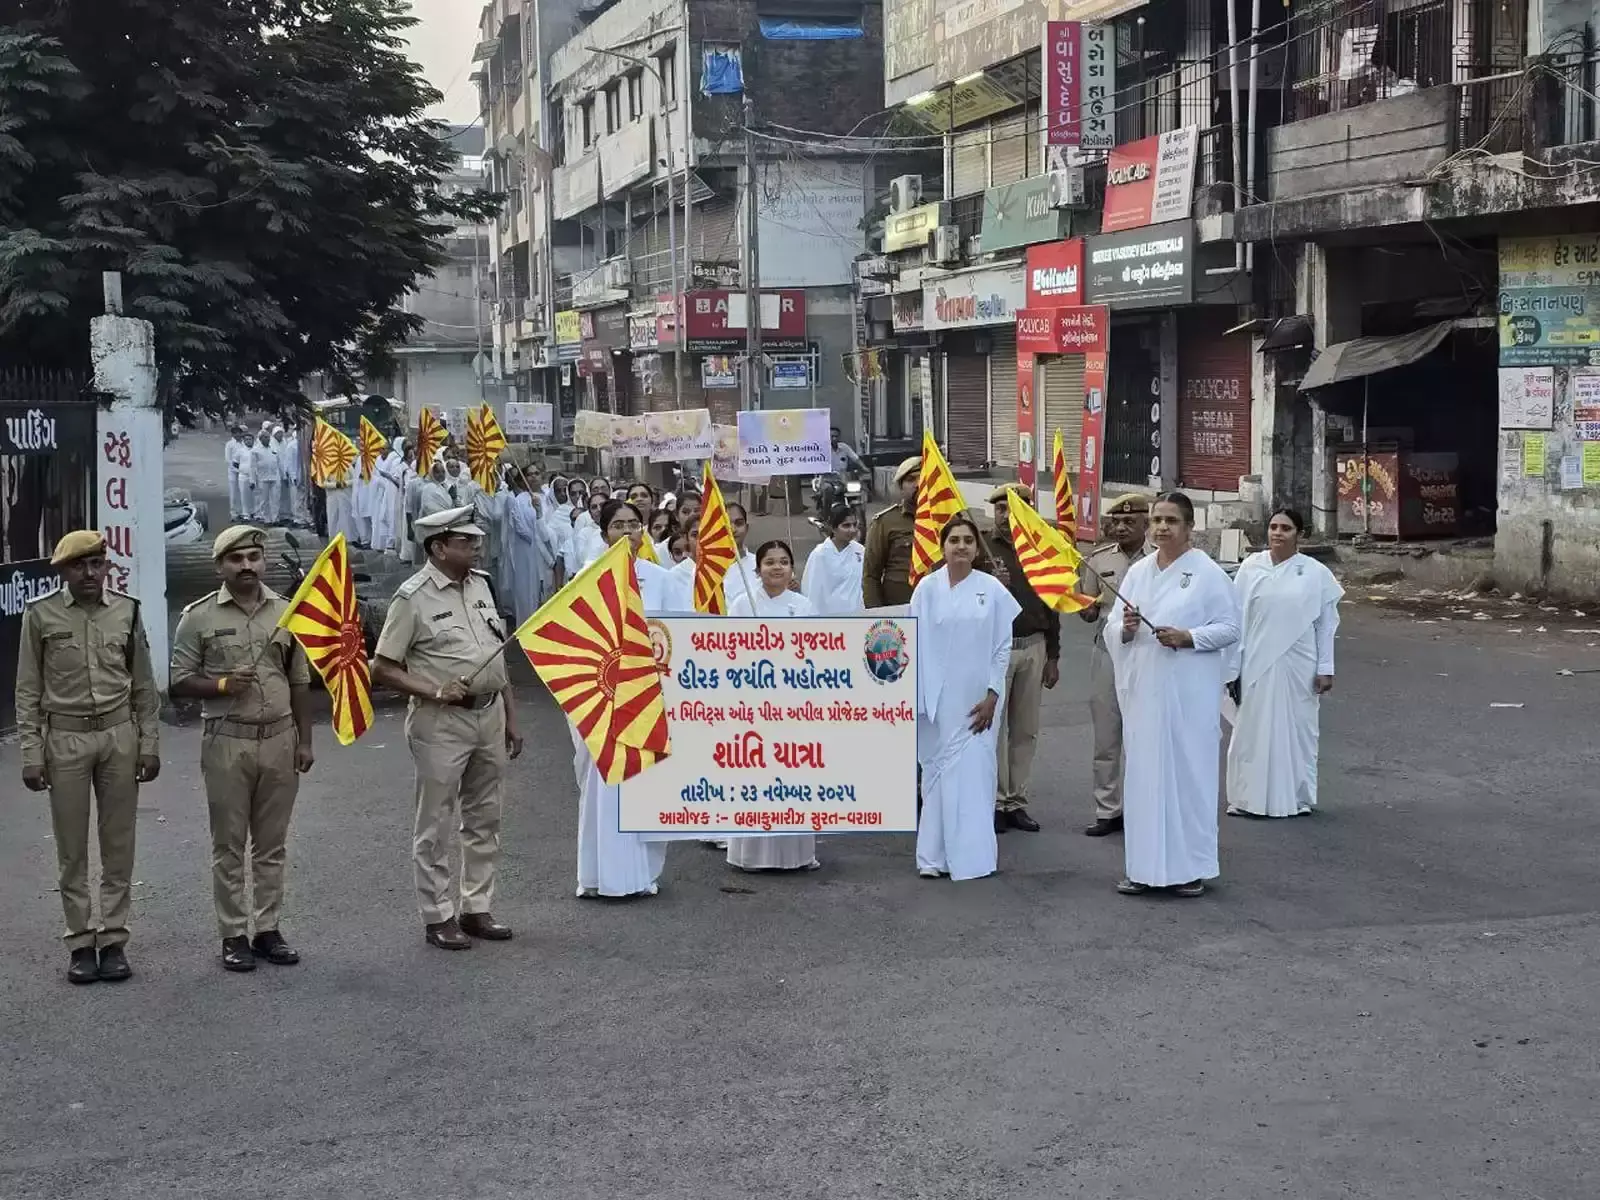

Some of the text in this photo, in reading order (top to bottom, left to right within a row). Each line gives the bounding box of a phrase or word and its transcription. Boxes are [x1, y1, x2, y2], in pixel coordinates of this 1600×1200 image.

[1018, 318, 1050, 333] POLYCAB
[1187, 379, 1240, 399] POLYCAB
[6, 408, 58, 450] પાર્કિંગ
[691, 624, 847, 660] બ્રહ્માકુમારીઝ ગુજરાત
[678, 659, 853, 689] હીરક જયંતિ મહોત્સવ
[680, 701, 725, 726] મિનિટ્સ
[729, 701, 754, 725] ઓફ
[758, 701, 783, 721] પીસ
[787, 701, 823, 721] અપીલ
[828, 700, 868, 722] પ્રોજેક્ટ
[713, 731, 826, 769] શાંતિ યાત્રા
[680, 777, 724, 801] તારીખ
[741, 785, 758, 801] ૨૩
[763, 777, 812, 801] નવેમ્બર
[817, 785, 857, 801] ૨૦૨૫
[659, 806, 710, 825] આયોજક
[734, 807, 805, 831] બ્રહ્માકુમારીઝ
[811, 810, 882, 831] સુરત-વરાછા
